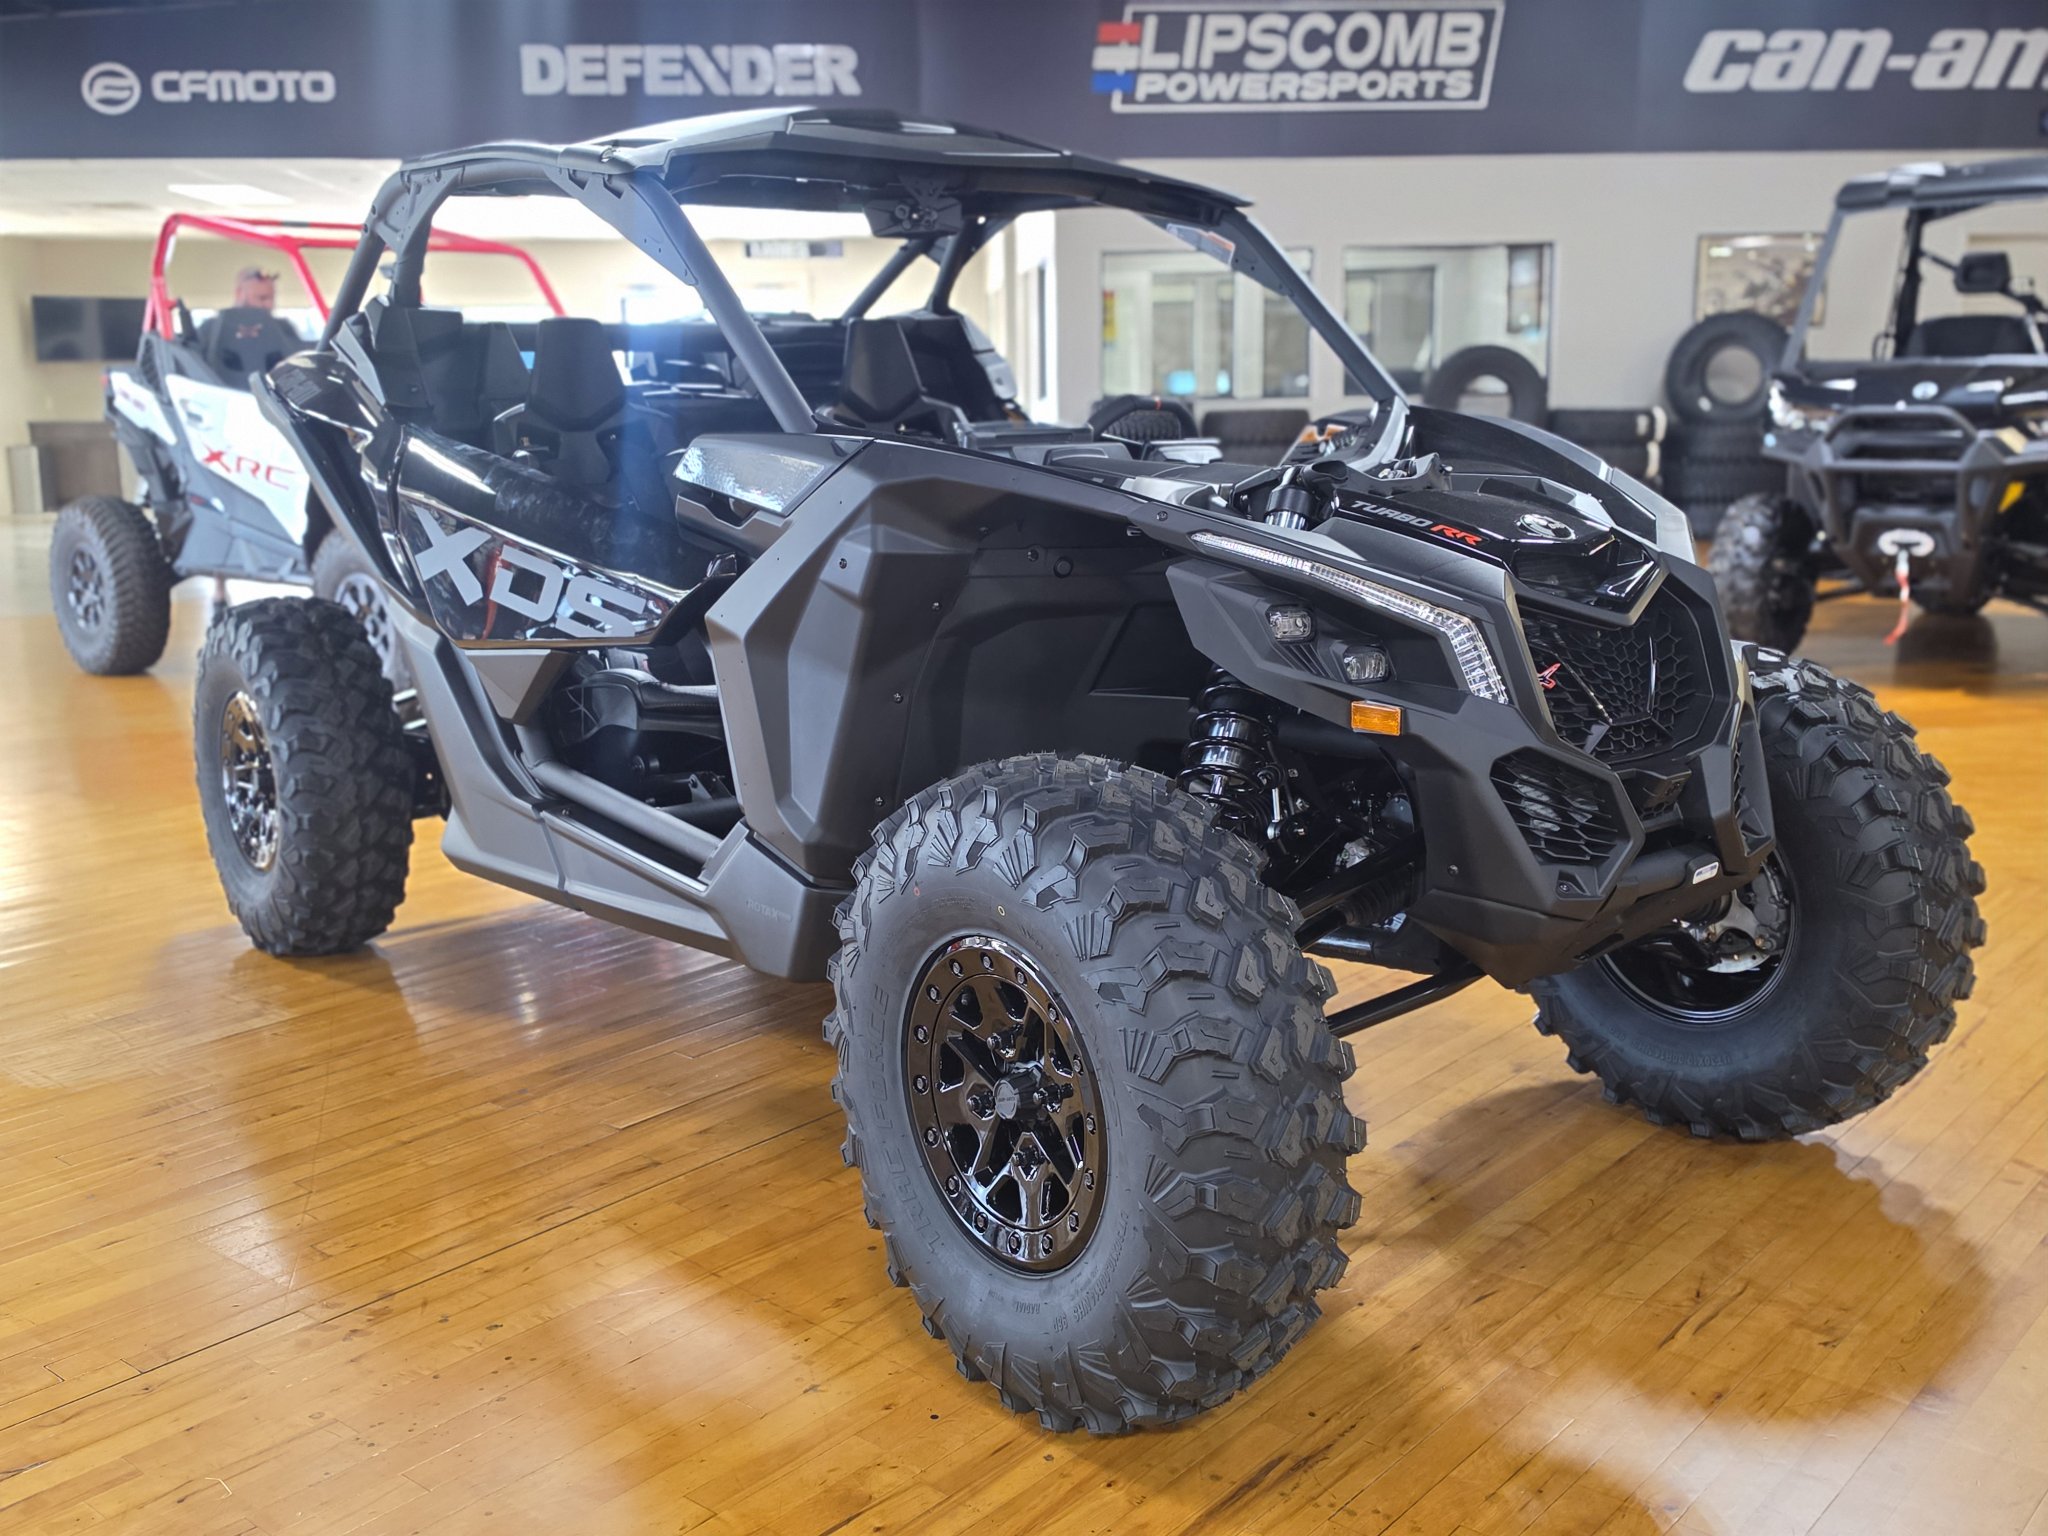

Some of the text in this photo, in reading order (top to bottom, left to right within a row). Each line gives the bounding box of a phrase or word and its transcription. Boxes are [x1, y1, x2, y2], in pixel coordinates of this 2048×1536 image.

[1140, 11, 1485, 70] LIPSCOMB
[151, 70, 336, 103] CFMOTO
[519, 43, 862, 96] DEFENDER
[1134, 69, 1474, 102] POWERSPORTS
[1350, 500, 1484, 546] TURBO RR
[410, 504, 648, 638] XDS
